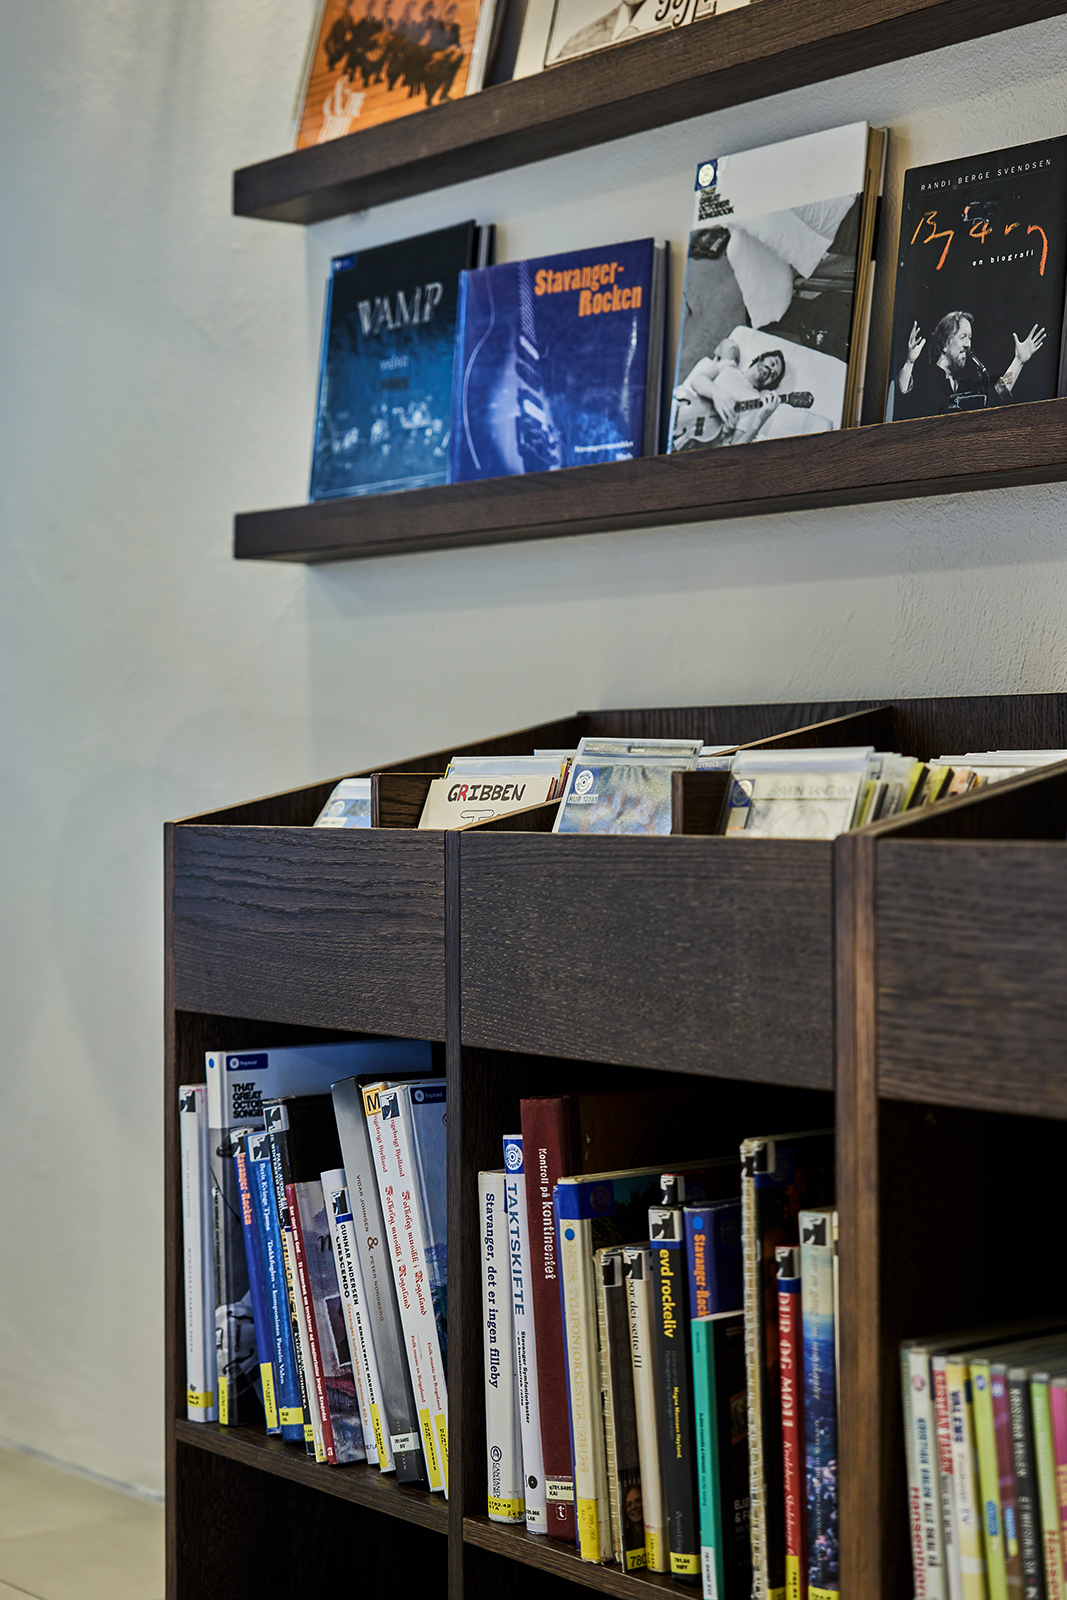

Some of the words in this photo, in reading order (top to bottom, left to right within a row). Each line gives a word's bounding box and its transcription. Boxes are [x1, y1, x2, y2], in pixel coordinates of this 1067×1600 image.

[920, 180, 951, 191] RANDI
[957, 171, 990, 184] BERGE
[997, 159, 1052, 177] SVENDSEN
[990, 249, 1035, 264] biografi
[534, 262, 625, 296] Stavanger-
[356, 281, 443, 336] VAMP
[578, 285, 642, 317] Rocken
[448, 783, 526, 802] GRIBBEN
[232, 1082, 256, 1092] THAT
[233, 1090, 263, 1101] GREAT
[390, 1119, 401, 1148] ngebrigt
[259, 1163, 269, 1180] Berit
[538, 1148, 550, 1184] Kontroll
[237, 1154, 252, 1226] tavanger-Rocken
[261, 1181, 270, 1206] Kvinge
[540, 1187, 551, 1198] på
[360, 1198, 371, 1232] JOHNSEN
[485, 1193, 496, 1262] Stavanger,
[367, 1236, 379, 1251] &
[507, 1183, 526, 1317] TAKTSKIFTE
[542, 1201, 557, 1280] kontinentet
[340, 1224, 351, 1259] GUNNAR
[346, 1261, 360, 1306] ANDERSEN
[369, 1255, 378, 1279] PETER
[487, 1265, 498, 1288] det
[659, 1249, 675, 1277] evd
[693, 1233, 710, 1317] Stavanger-Rock
[373, 1281, 385, 1322] NORDBERG
[488, 1291, 497, 1305] er
[628, 1280, 636, 1299] por
[271, 1290, 280, 1336] komponisten
[346, 1303, 357, 1337] Stavanger
[630, 1301, 639, 1320] dei
[661, 1279, 678, 1338] rockeliv
[778, 1292, 792, 1333] DUR
[487, 1308, 499, 1344] ingen
[631, 1322, 641, 1351] sette
[520, 1331, 528, 1366] Stavanger
[569, 1287, 587, 1421] SYMFONIORKESTER
[634, 1354, 643, 1370] III
[488, 1347, 501, 1389] filleby
[521, 1367, 531, 1424] Symfoniorkester
[672, 1386, 681, 1406] Magne
[781, 1375, 794, 1427] MOLL
[577, 1425, 590, 1473] 1938-1988
[674, 1434, 683, 1459] Høyland,
[674, 1511, 683, 1533] Øyvind
[675, 1533, 683, 1553] Elling
